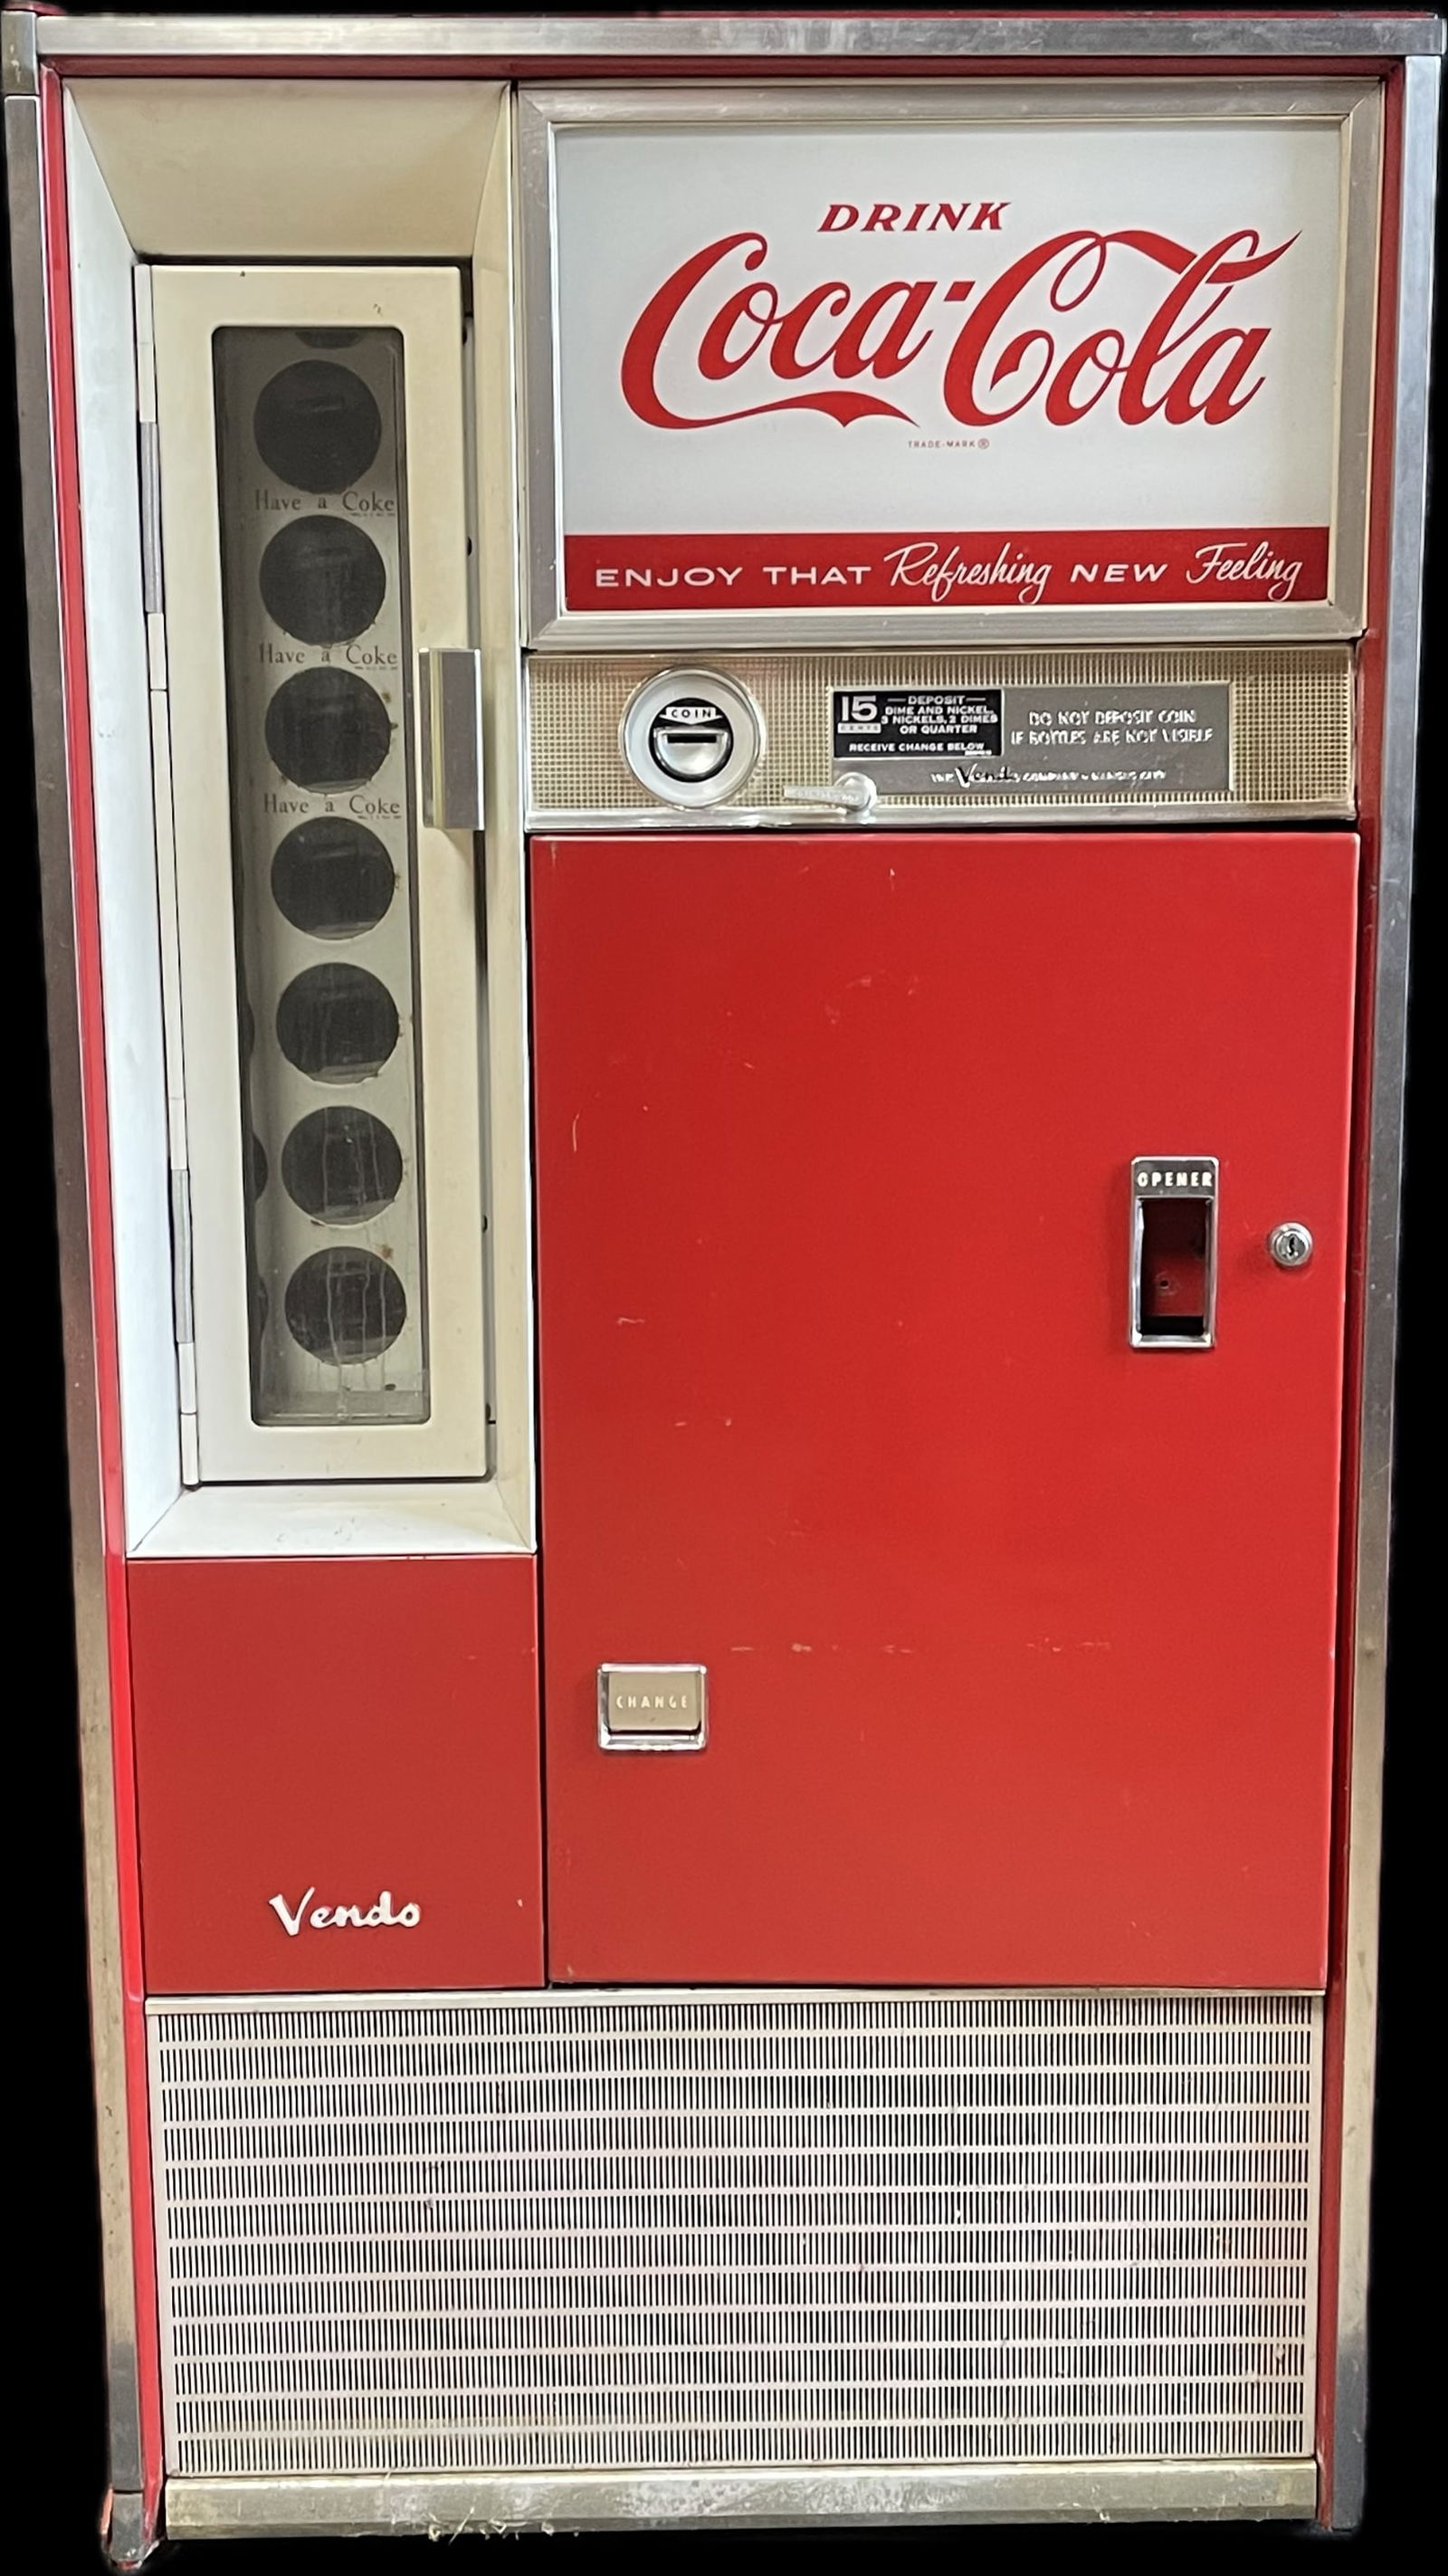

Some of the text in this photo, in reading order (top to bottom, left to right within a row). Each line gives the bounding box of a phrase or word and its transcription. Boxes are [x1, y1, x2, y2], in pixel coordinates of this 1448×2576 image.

[817, 201, 1012, 233] DRINK
[621, 229, 1302, 428] Coca-Cola
[254, 490, 395, 512] Have a Coke
[595, 541, 1303, 606] ENJOY THAT Refreshing NEW Feeling
[259, 643, 397, 665] Have a Coke
[841, 695, 878, 722] 15
[908, 695, 966, 705] DEPOSIT
[671, 709, 713, 719] COIN
[881, 715, 889, 725] 3
[949, 715, 957, 725] 2
[961, 713, 998, 723] DIMES
[885, 706, 914, 716] DIME
[918, 706, 943, 715] AND
[1029, 711, 1052, 726] DO
[1058, 711, 1090, 725] NOT
[900, 724, 977, 734] OR QUARTER
[1011, 730, 1024, 745] IF
[1126, 728, 1157, 743] NOT
[849, 742, 985, 752] RECEIVE CHANGE BELOW
[263, 793, 400, 815] Have a Coke
[1137, 1171, 1213, 1188] OPENER
[616, 1695, 688, 1709] CHANGE
[269, 1886, 422, 1936] Vendo
